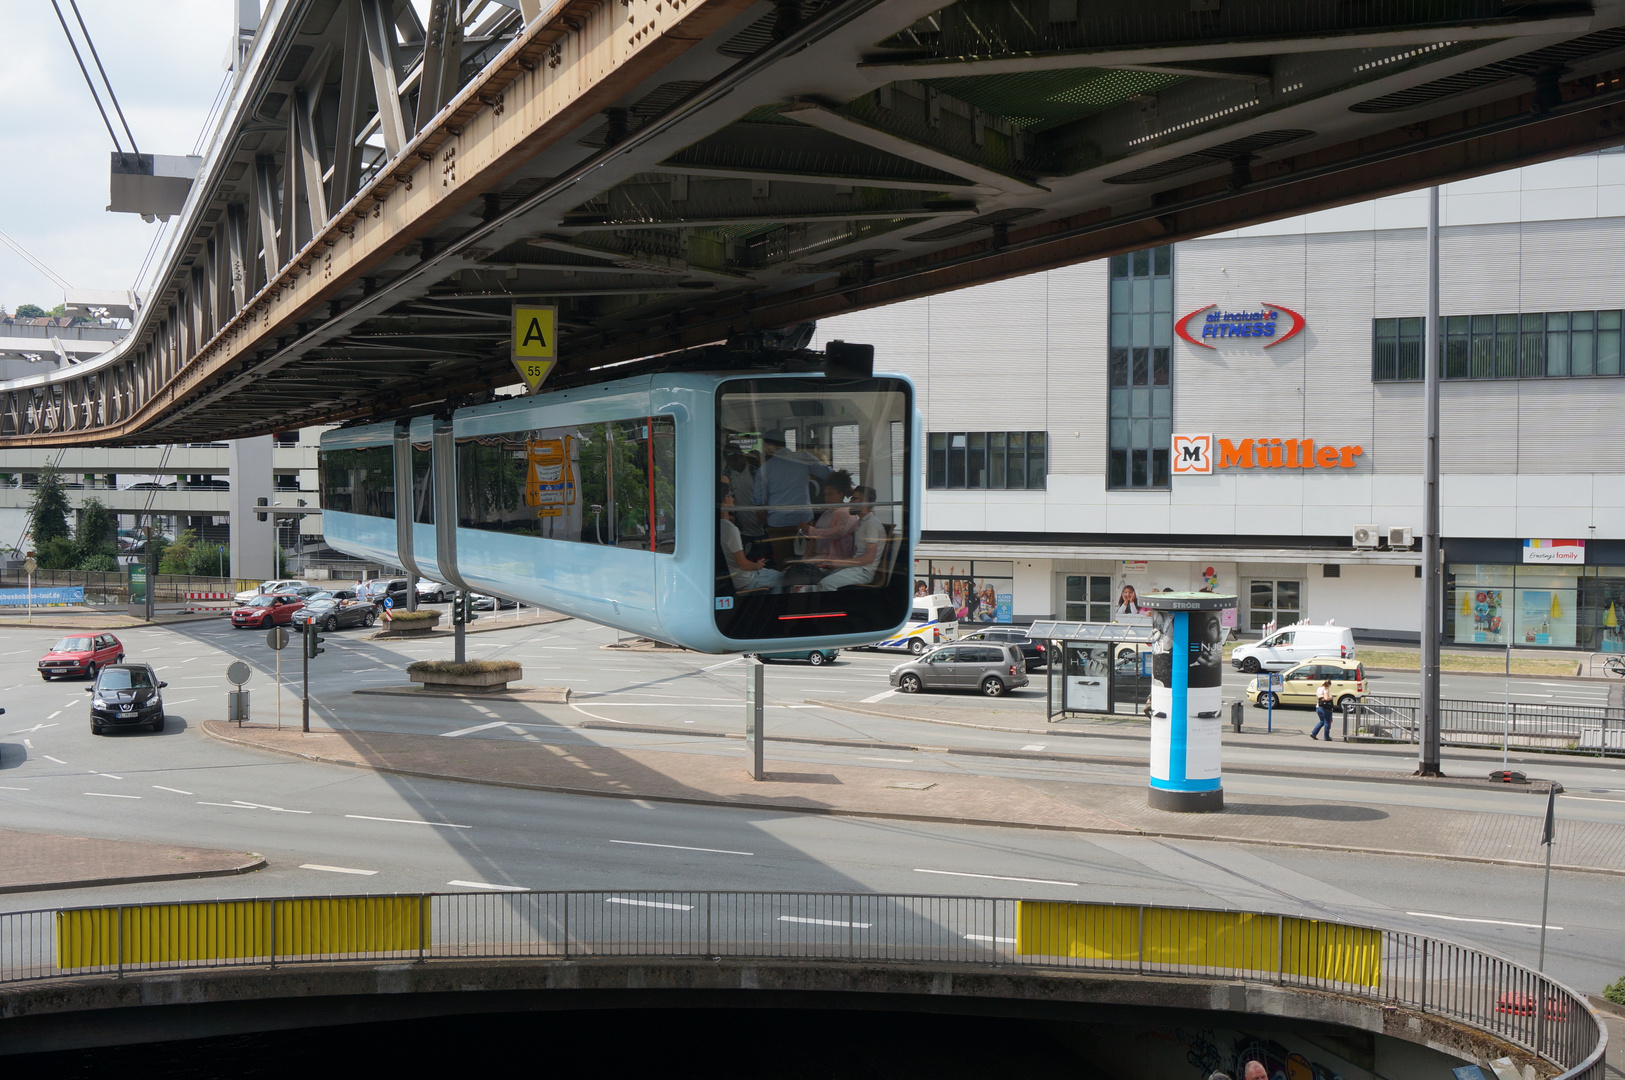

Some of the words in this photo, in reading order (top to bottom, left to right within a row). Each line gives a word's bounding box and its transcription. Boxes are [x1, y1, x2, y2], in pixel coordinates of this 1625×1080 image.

[1206, 311, 1220, 322] all
[1223, 309, 1278, 321] inclusive
[522, 317, 547, 348] A
[1202, 321, 1277, 338] FITNESS
[528, 366, 541, 377] 55
[1182, 446, 1201, 462] M
[1217, 438, 1363, 468] Müller
[1556, 551, 1578, 560] family
[718, 598, 731, 608] 11
